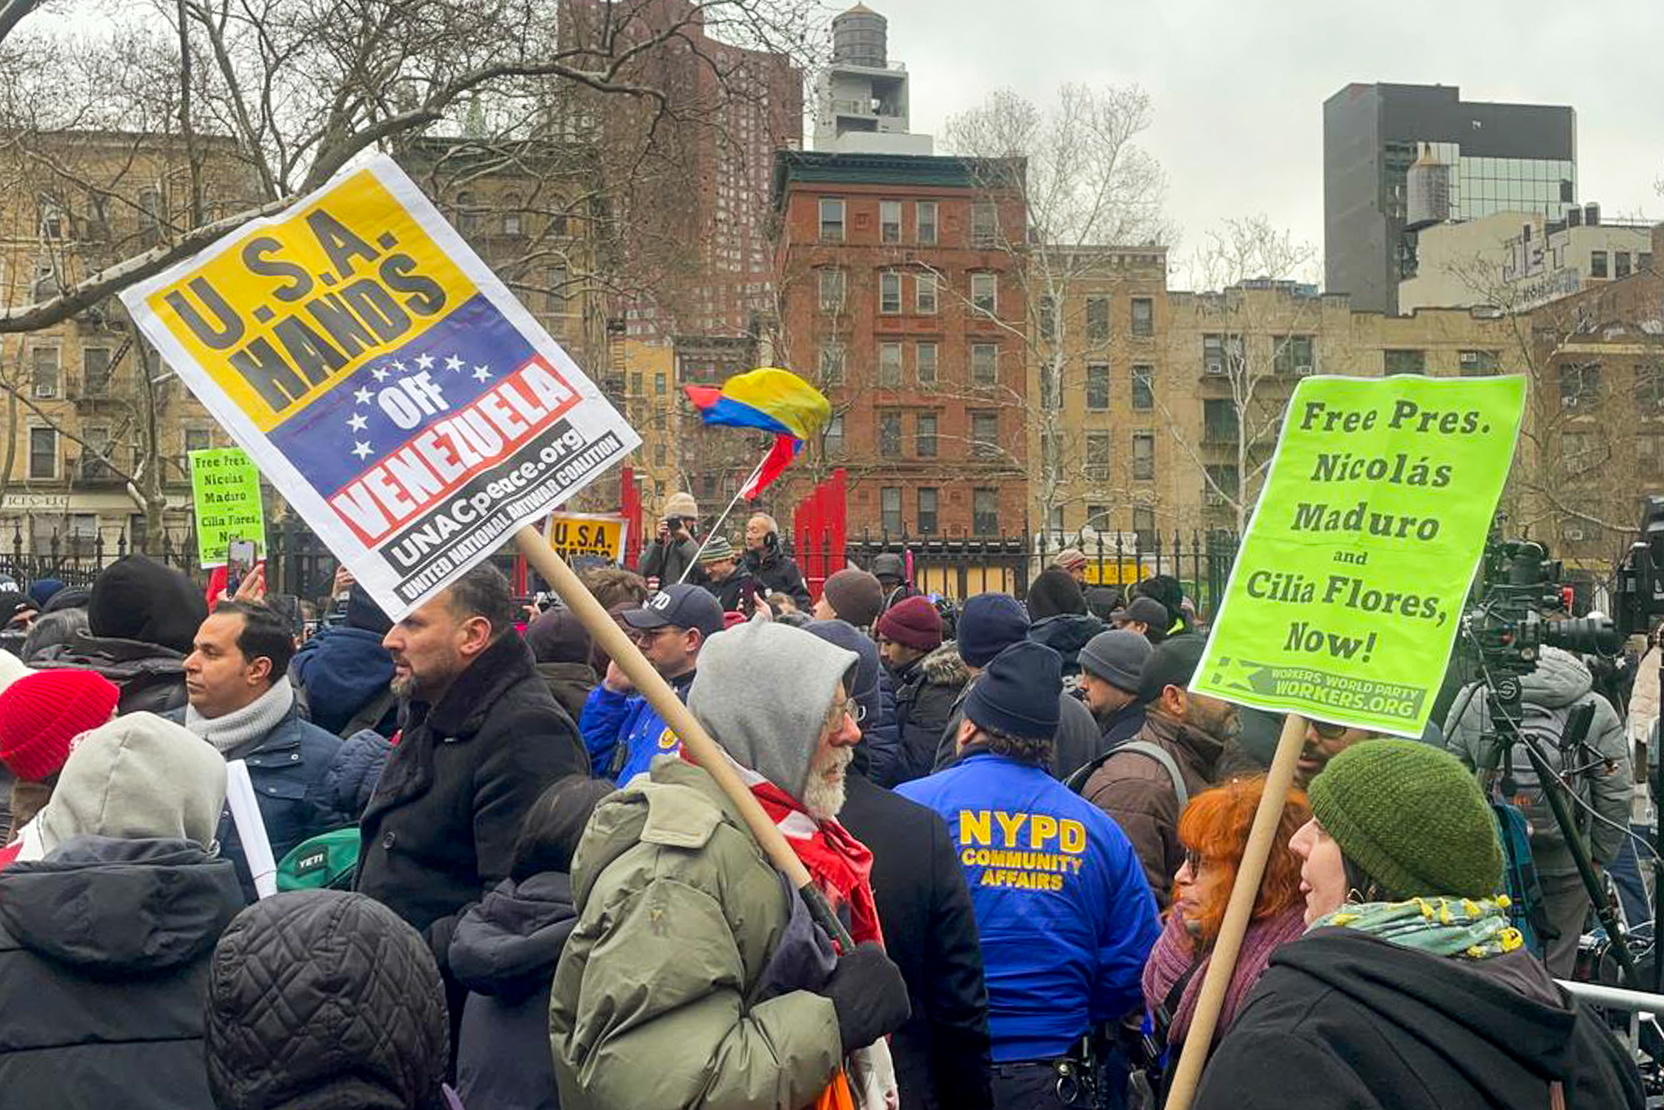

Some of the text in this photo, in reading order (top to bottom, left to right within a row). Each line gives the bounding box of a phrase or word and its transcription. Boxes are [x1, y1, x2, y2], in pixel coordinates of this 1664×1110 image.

[163, 209, 398, 350] U.S.A.
[227, 254, 447, 413] HANDS
[378, 370, 449, 430] OFF
[1300, 400, 1490, 434] Free Pres.
[195, 457, 220, 469] Free
[331, 362, 574, 540] VENEZUELA
[1311, 453, 1453, 487] Nicolás
[391, 428, 584, 567] UNACpeace.org
[401, 559, 457, 599] UNITED
[453, 511, 512, 566] NATIONAL
[508, 475, 565, 520] ANTIWAR
[561, 435, 621, 486] COALITION
[554, 523, 612, 548] U.S.A.
[1291, 502, 1440, 540] Maduro
[1333, 551, 1368, 565] and
[1247, 571, 1446, 628] Cilia Flores,
[1283, 622, 1377, 663] Now!
[1272, 669, 1419, 700] WORKERS WORLD PARTY
[1275, 680, 1414, 717] WORKERS.ORG
[960, 809, 1087, 854] NYPD
[299, 853, 324, 868] YETI
[961, 848, 1083, 875] COMMUNITY
[981, 869, 1064, 891] AFFAIRS
